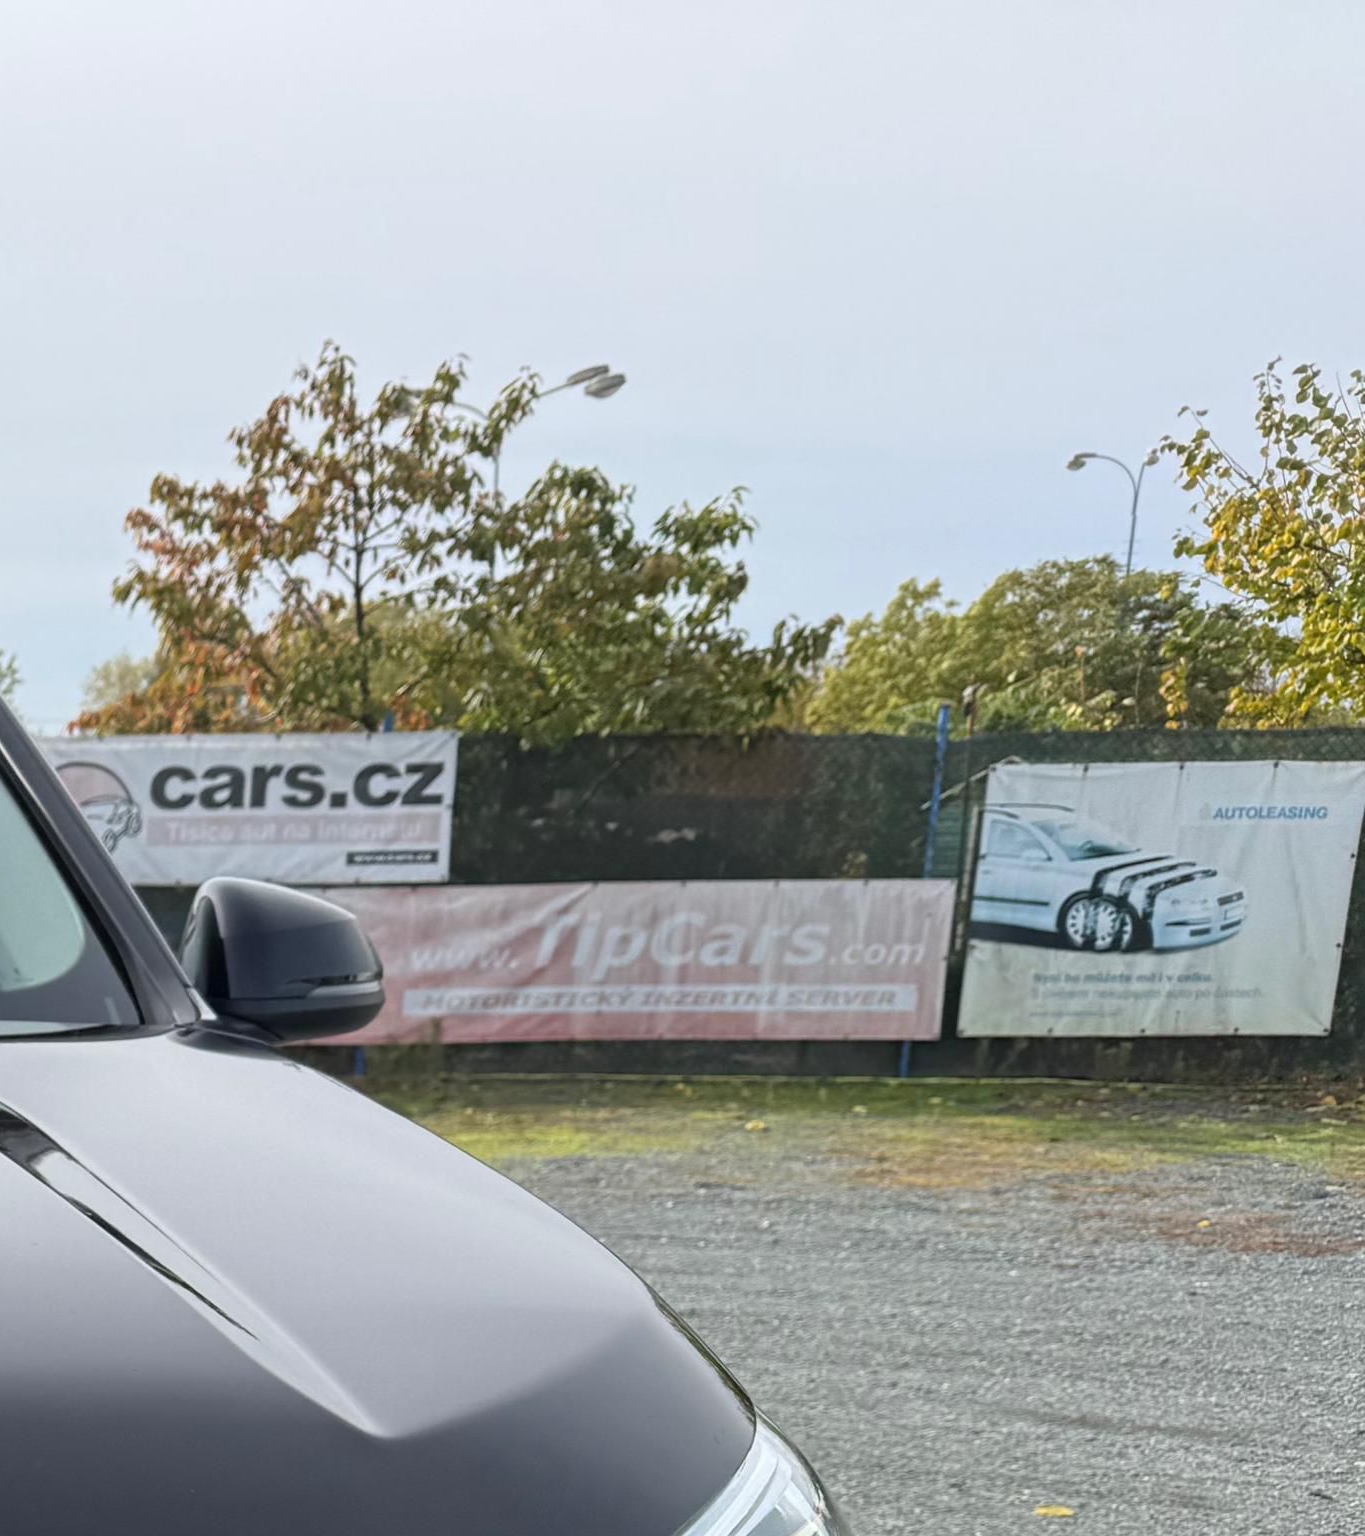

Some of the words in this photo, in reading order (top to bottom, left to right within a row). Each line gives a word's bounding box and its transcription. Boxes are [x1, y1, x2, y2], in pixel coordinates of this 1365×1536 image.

[150, 761, 445, 809] cars.cz
[1212, 806, 1328, 820] AUTOLEASING
[786, 987, 897, 1007] SERVER
